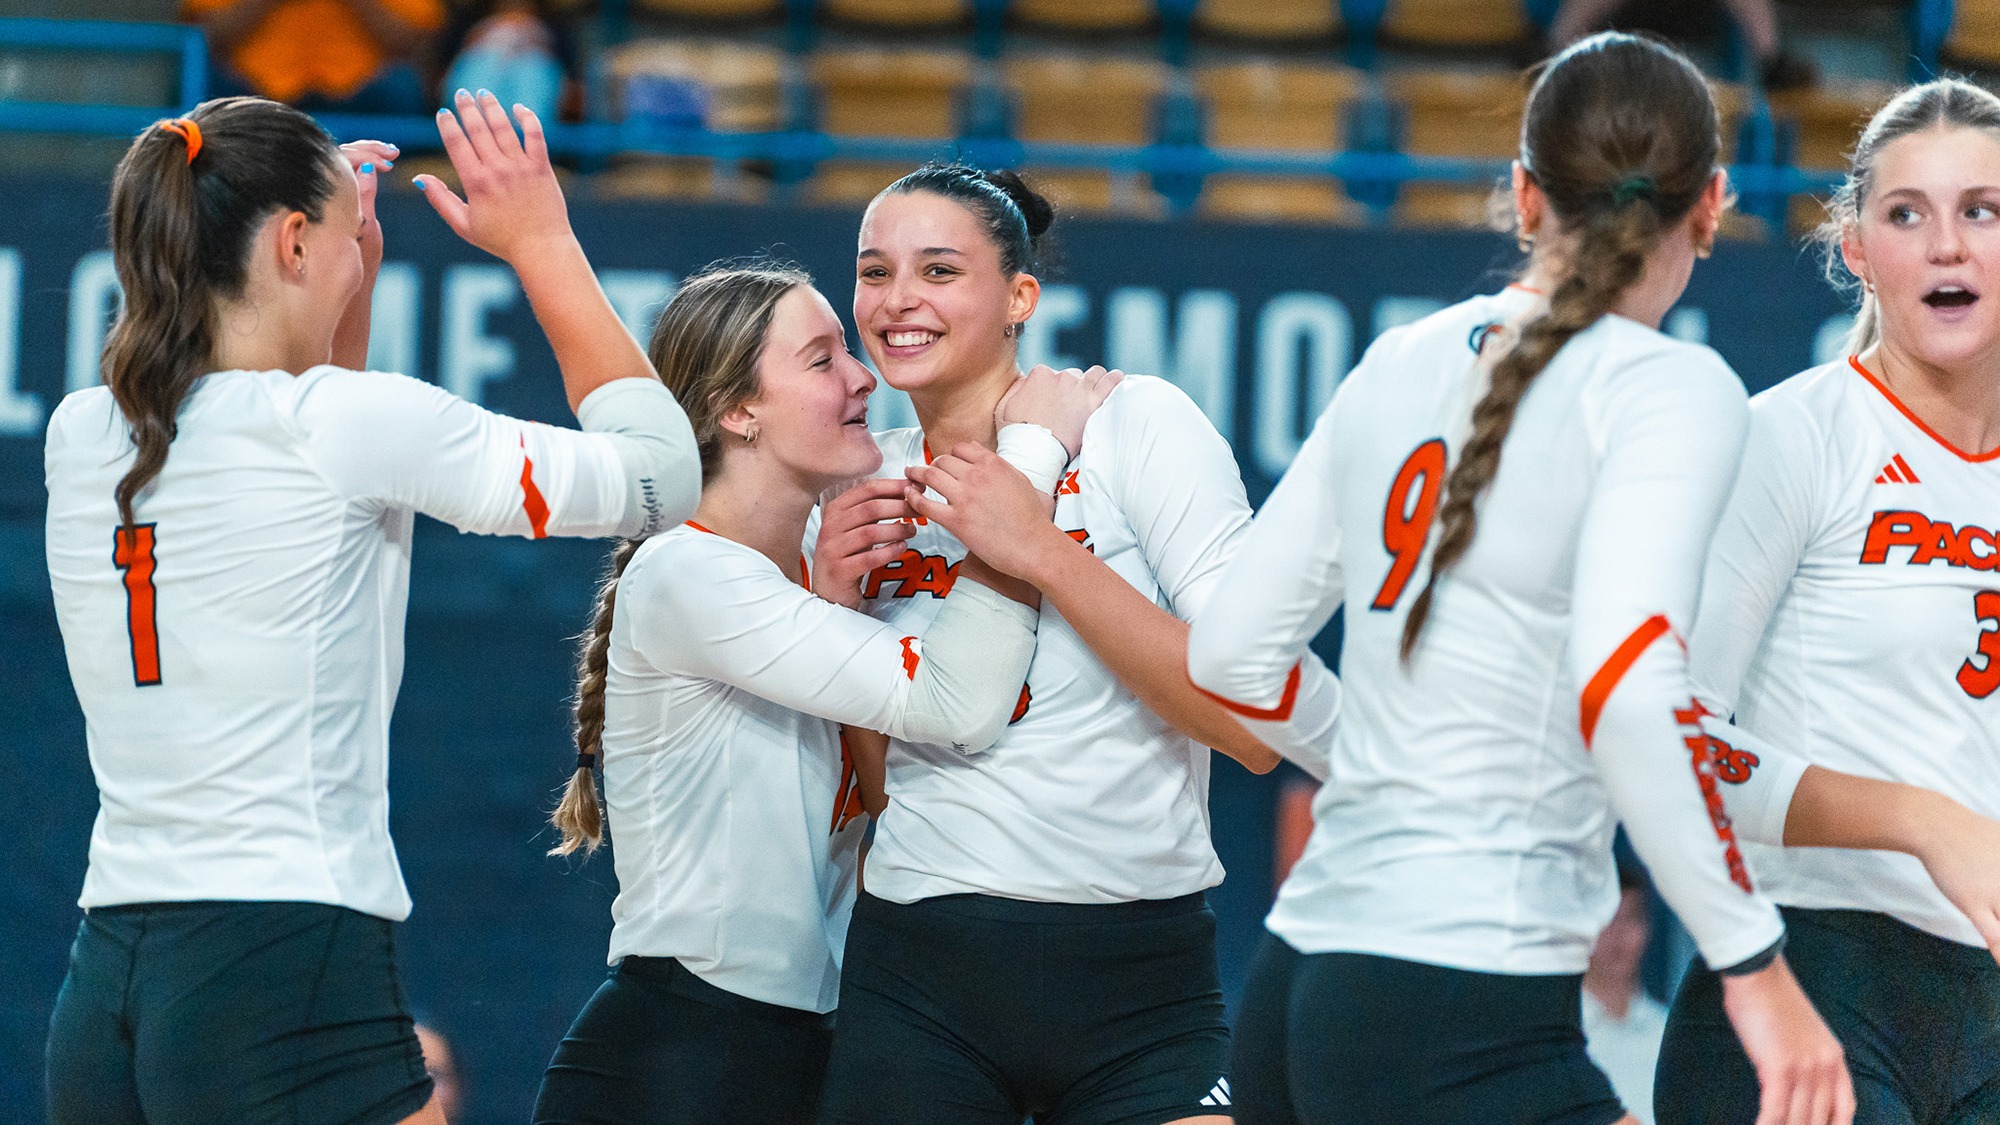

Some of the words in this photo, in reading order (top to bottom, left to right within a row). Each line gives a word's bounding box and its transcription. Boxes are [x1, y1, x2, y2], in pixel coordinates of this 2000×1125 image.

[112, 521, 163, 687] 1
[1370, 435, 1447, 612] 9
[1859, 508, 2000, 573] PAC
